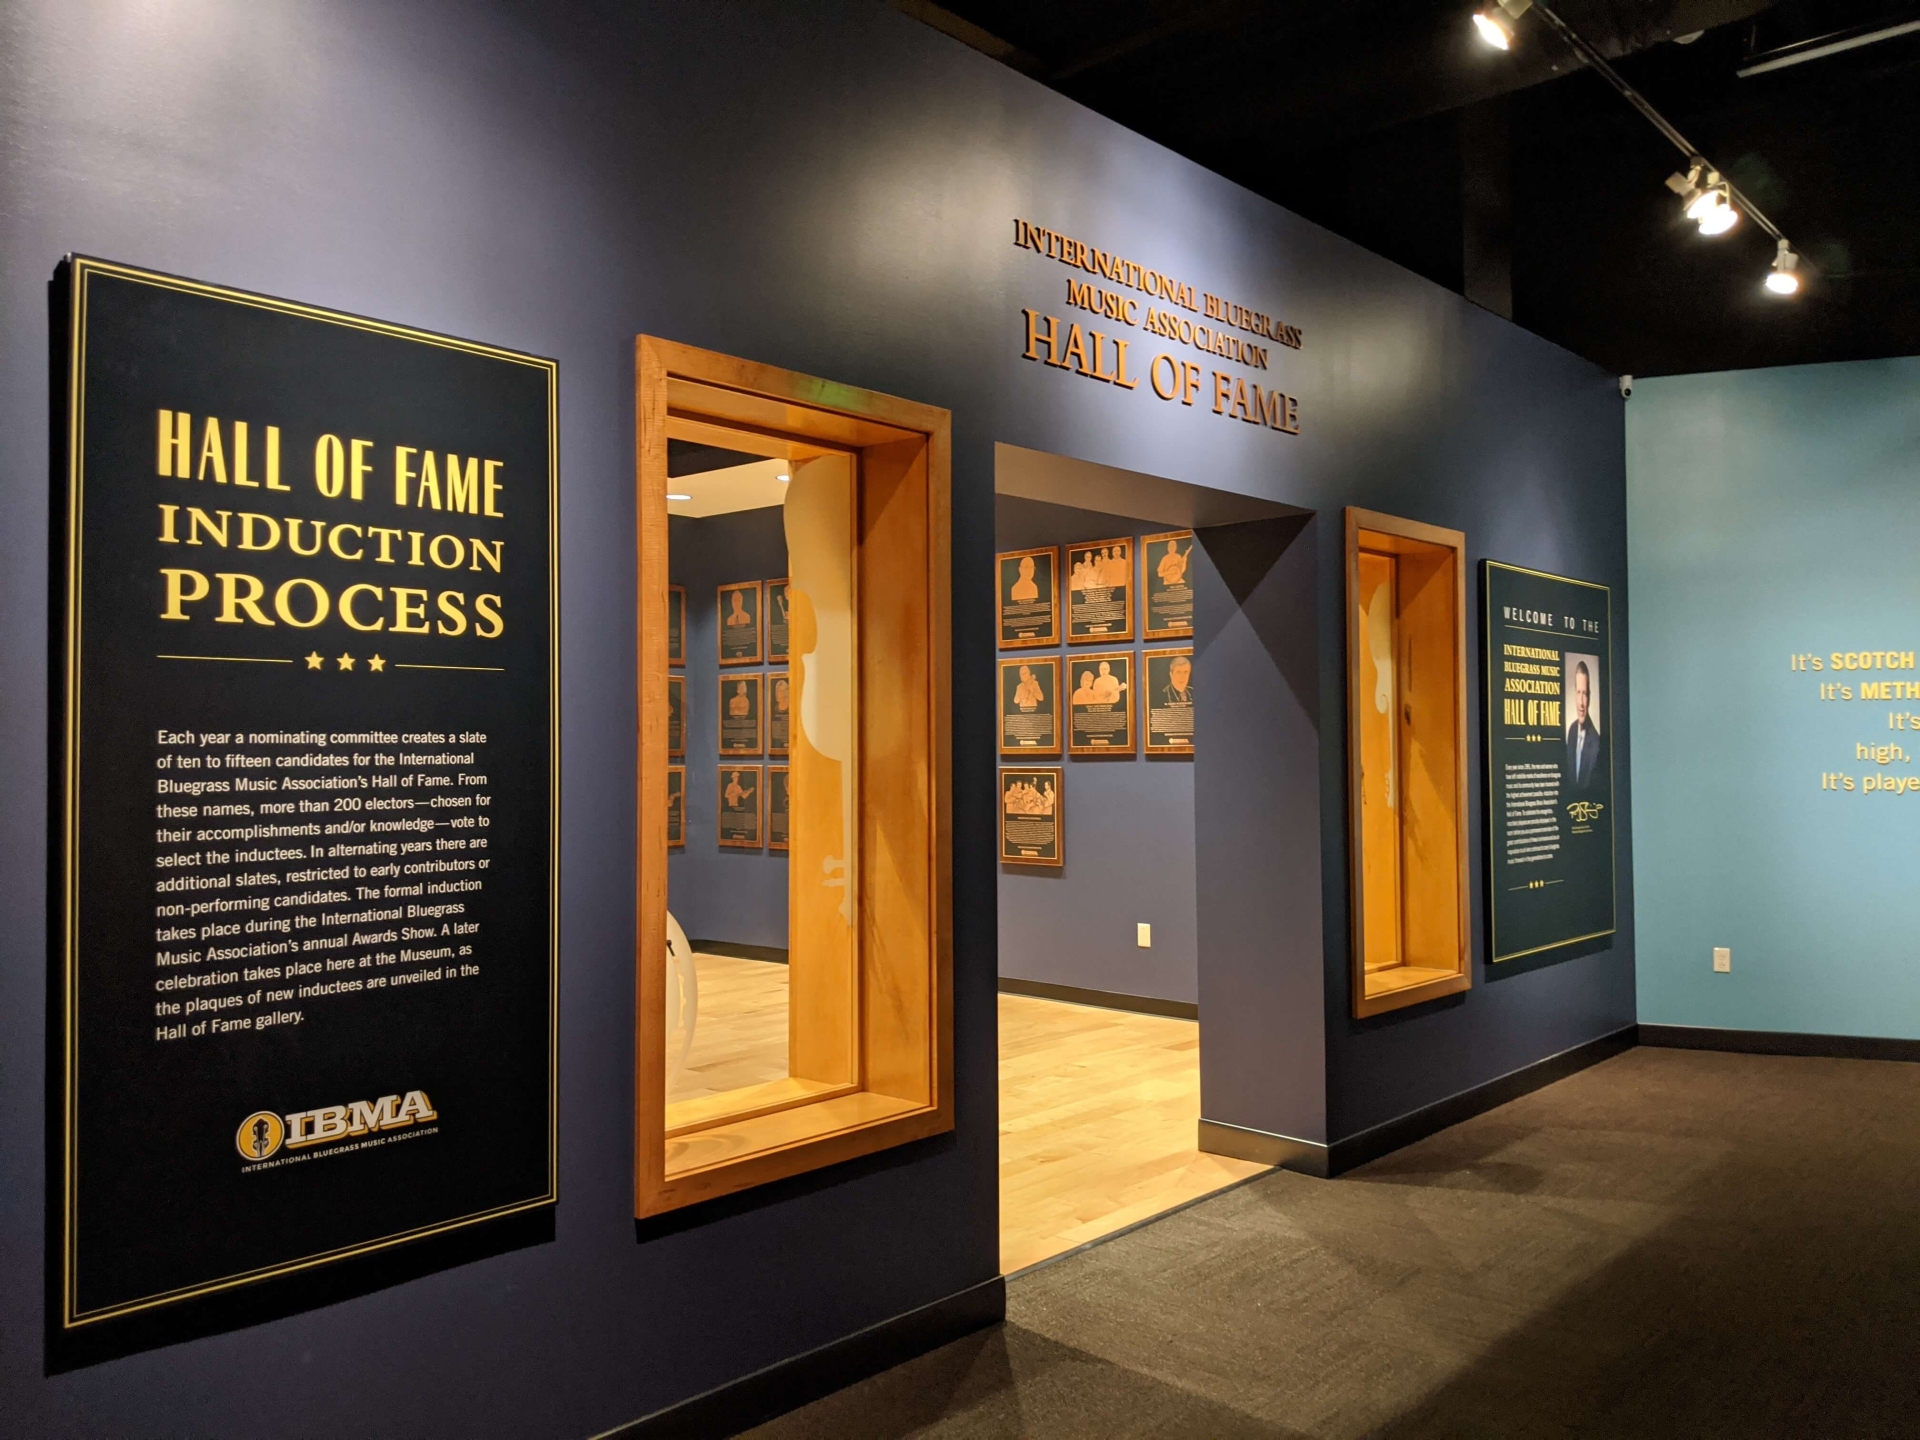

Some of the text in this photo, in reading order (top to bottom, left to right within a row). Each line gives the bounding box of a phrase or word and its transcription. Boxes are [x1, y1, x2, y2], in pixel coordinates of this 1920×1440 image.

[1013, 218, 1303, 349] INTERNATIONAL BLUEGRASS
[1066, 278, 1269, 370] MUSIC ASSOCIATION
[1022, 308, 1300, 435] HALL OF FAME
[158, 409, 503, 517] HALL OF FAME
[158, 504, 504, 573] INDUCTION
[160, 569, 503, 638] PROCESS
[1504, 607, 1598, 633] WELCOME TO THE
[1504, 644, 1560, 661] INTERNATIONAL
[1791, 651, 1915, 671] It’s SCOTCH
[1504, 661, 1560, 676] BLUEGRASS MUSIC
[1504, 678, 1560, 695] ASSOCIATION
[1820, 682, 1853, 700] It’s
[1504, 698, 1561, 726] HALL OF FAME
[158, 730, 486, 747] Each year a nominating committee creates a slate
[1856, 742, 1911, 764] high,
[157, 752, 474, 768] of ten to fifteen candidates for the International
[158, 773, 487, 795] Bluegrass Music Association’s Hall of Fame. From
[1822, 772, 1855, 791] It’s
[156, 804, 198, 818] these
[203, 805, 254, 816] names,
[260, 803, 295, 814] more
[299, 800, 329, 813] than
[334, 798, 361, 811] 200
[476, 794, 491, 805] for
[156, 828, 192, 842] their
[197, 823, 321, 841] accomplishments
[325, 820, 366, 834] and/or
[478, 816, 489, 827] to
[156, 838, 487, 867] select the inductees. In alternating years there are
[156, 859, 490, 892] additional slates, restricted to early contributors or
[157, 879, 481, 920] non-performing candidates. The formal induction
[156, 904, 464, 941] takes place during the International Bluegrass
[157, 922, 479, 966] Music Association’s annual Awards Show. A later
[156, 945, 472, 991] celebration takes place here at the Museum, as
[156, 964, 479, 1016] the plaques of new inductees are unveiled in the
[157, 1011, 304, 1040] Hall of Fame gallery.
[285, 1091, 438, 1149] IBMA
[242, 1128, 438, 1172] INTERNATIONAL BLUEGRASS MUSIC ASSOCIATION
